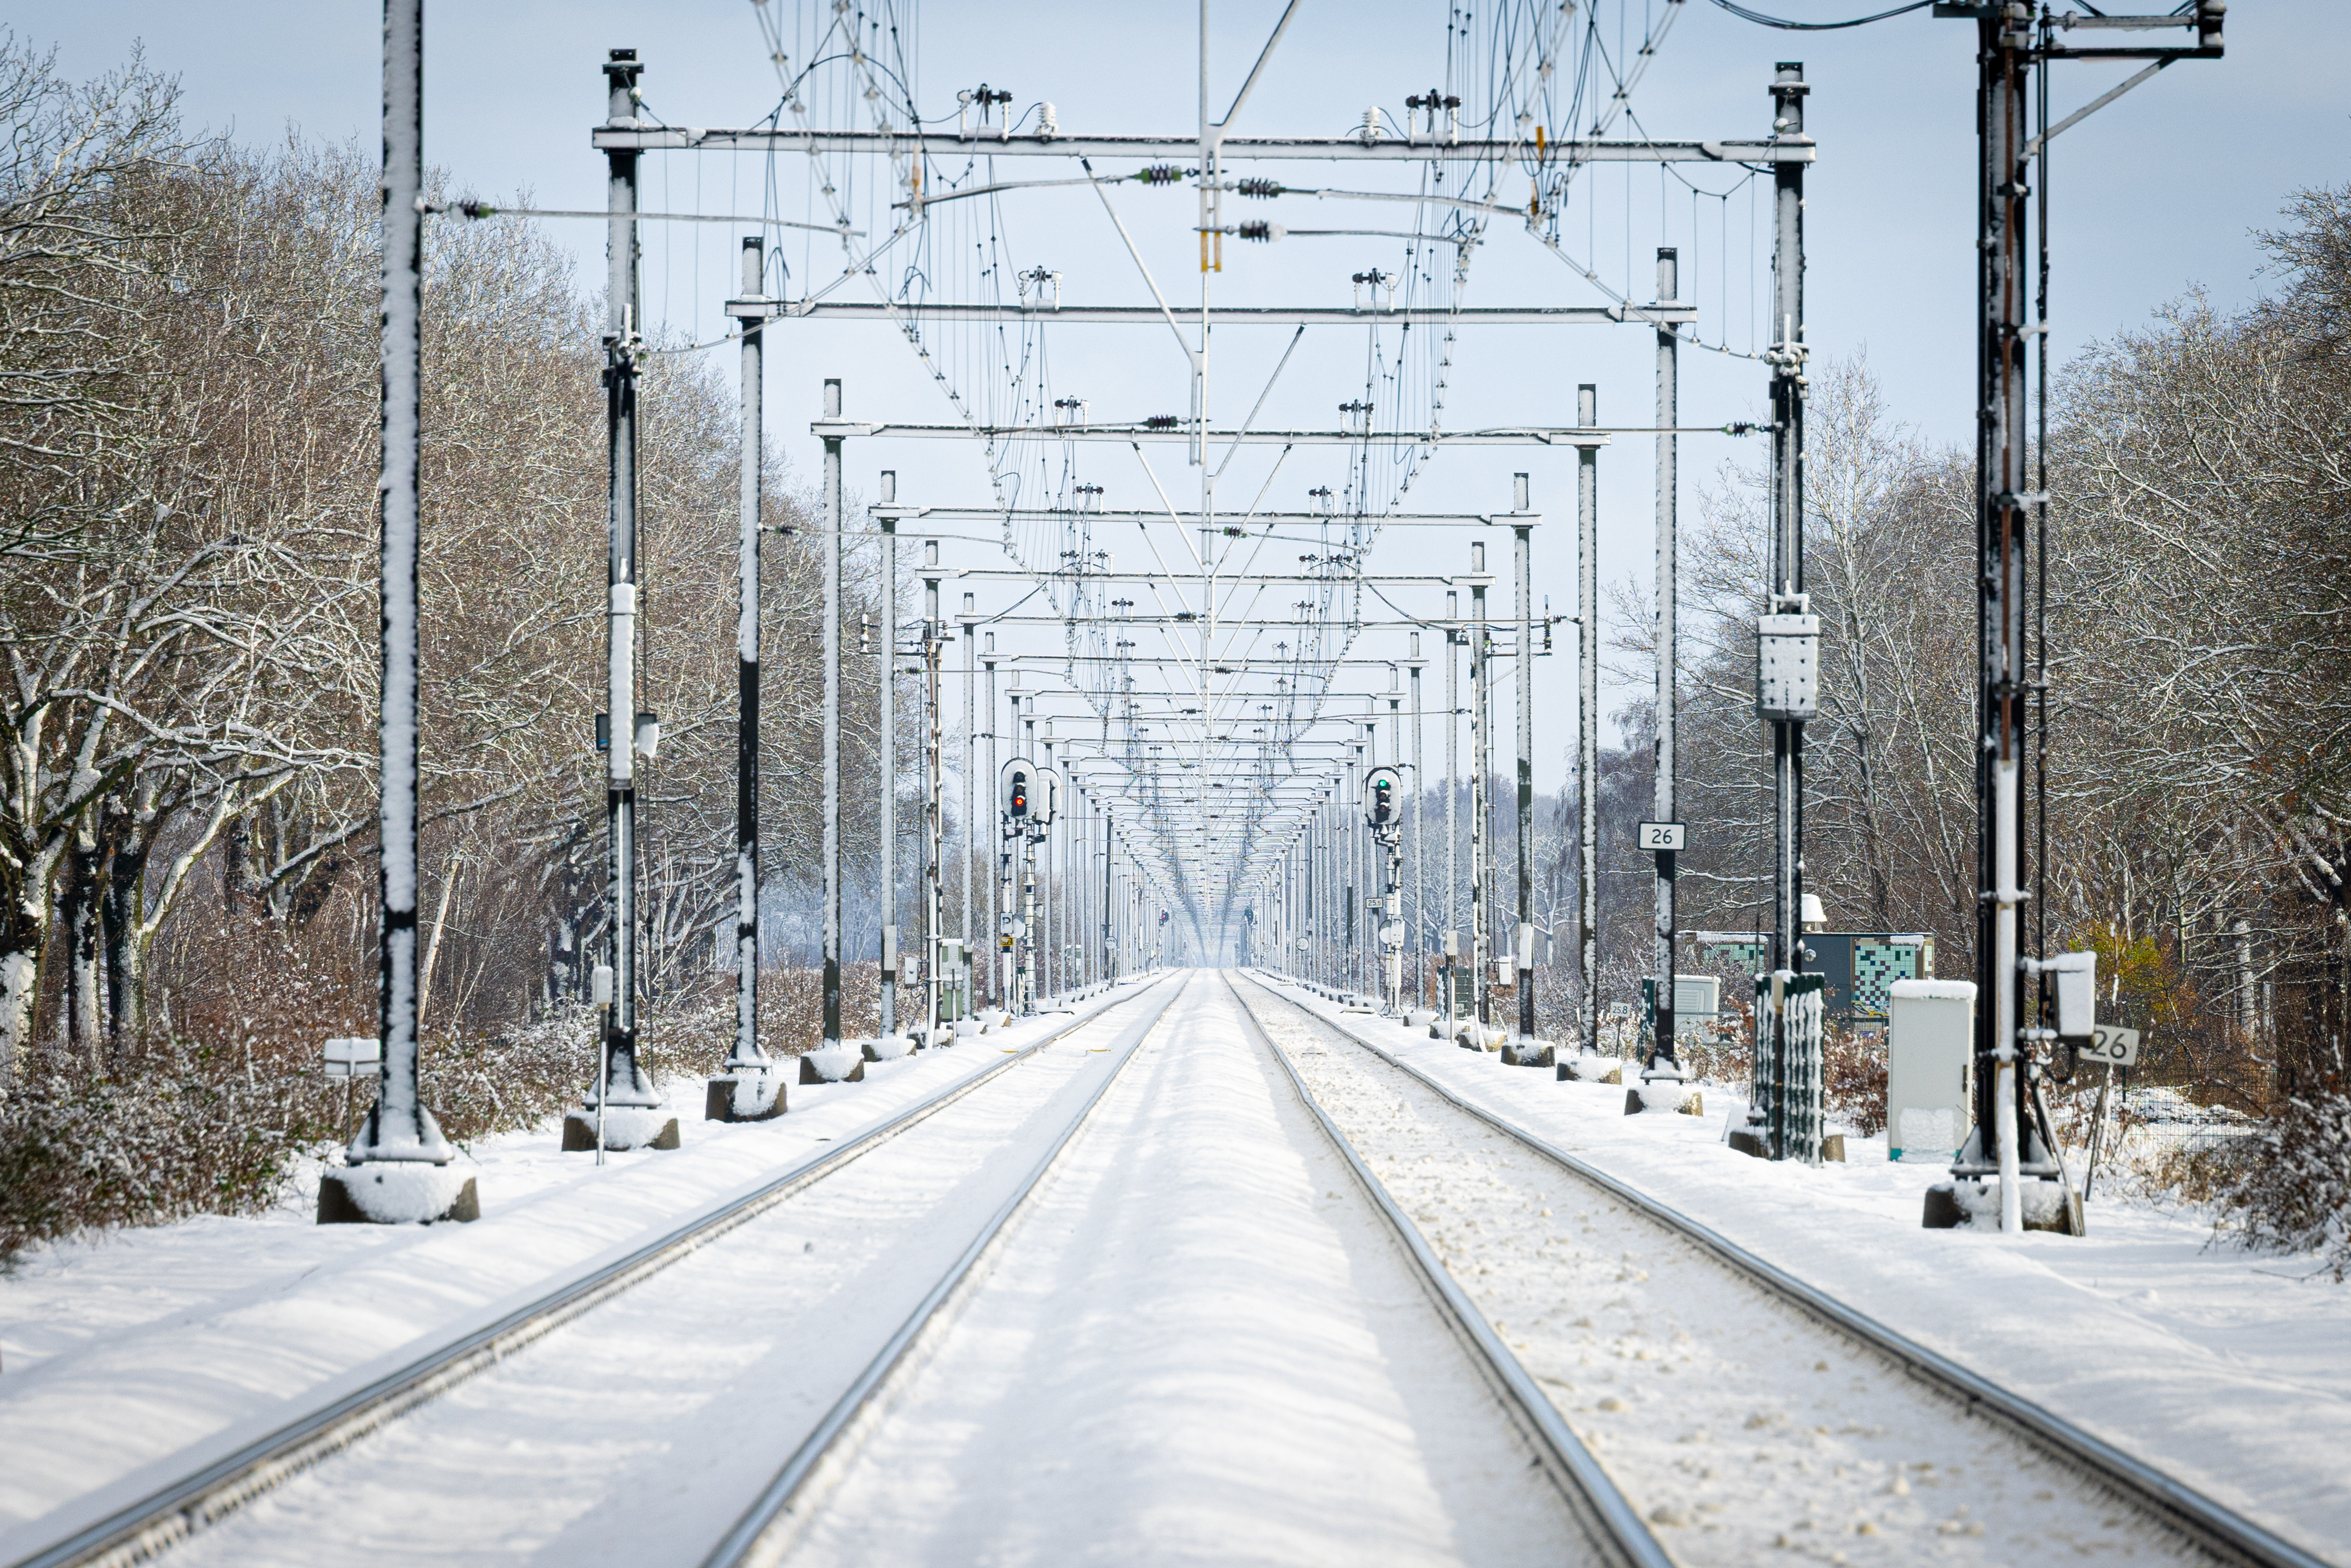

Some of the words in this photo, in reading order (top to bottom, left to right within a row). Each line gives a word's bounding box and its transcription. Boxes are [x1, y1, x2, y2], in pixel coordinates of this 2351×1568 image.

[1652, 829, 1672, 844] 26
[1613, 1006, 1628, 1014] 25.8
[2090, 1030, 2126, 1059] 26
